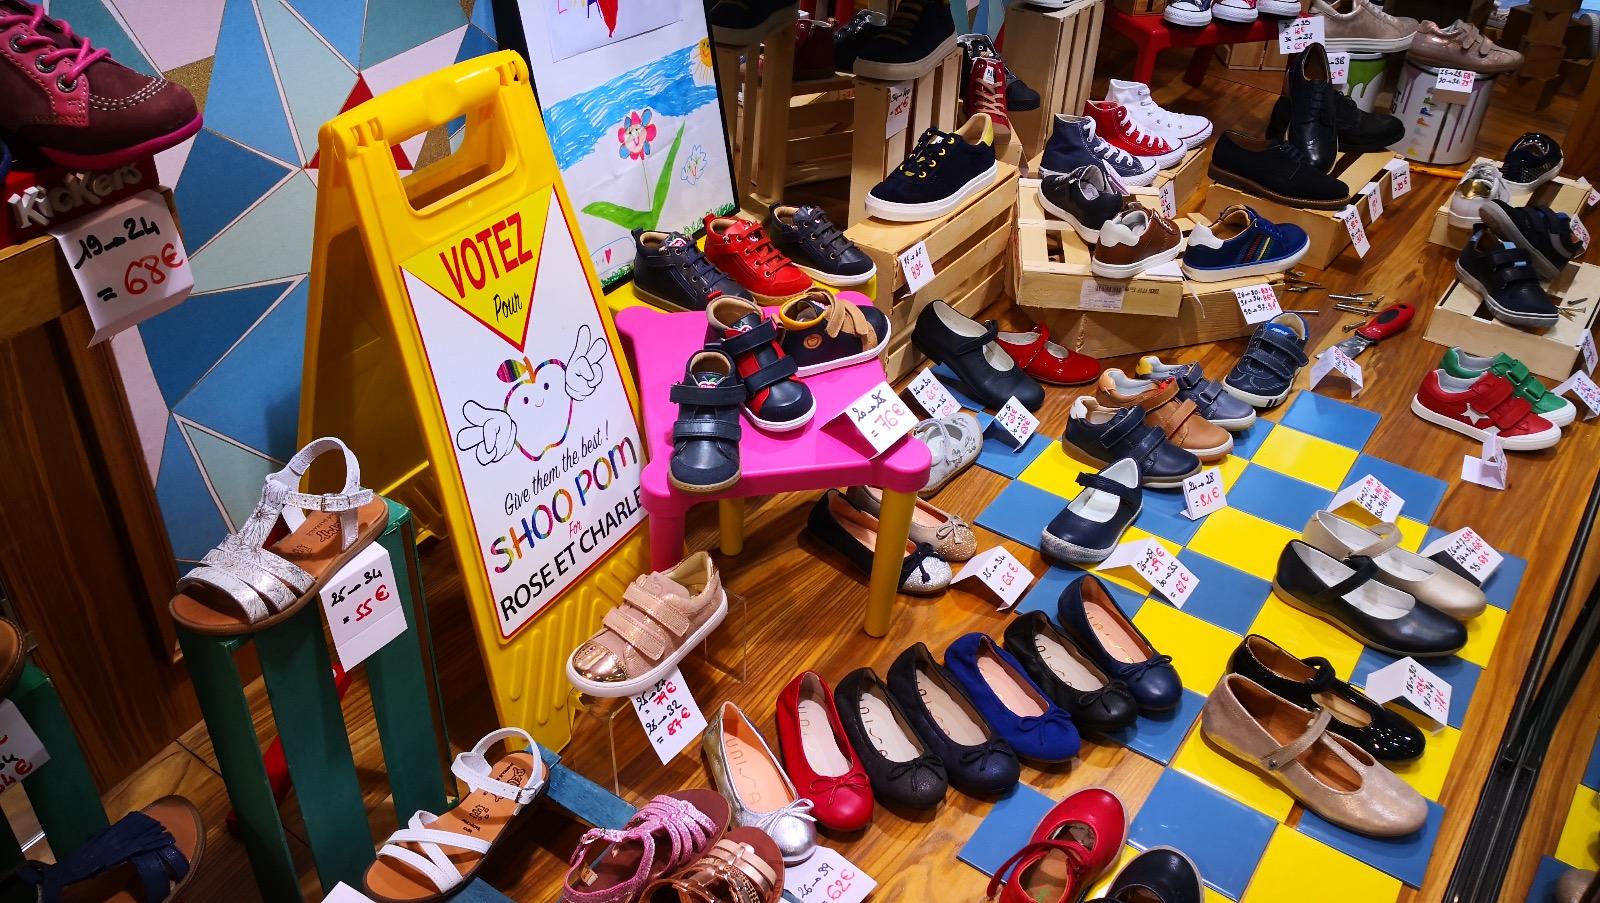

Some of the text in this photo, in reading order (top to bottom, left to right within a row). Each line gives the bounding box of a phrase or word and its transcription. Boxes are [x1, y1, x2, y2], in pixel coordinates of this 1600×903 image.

[74, 217, 160, 269] 19 24
[439, 212, 533, 299] VOTEZ
[124, 243, 183, 294] 68€
[493, 292, 522, 323] Pour
[874, 403, 905, 431] 76€
[504, 488, 530, 516] Give
[532, 464, 560, 495] them
[562, 447, 579, 473] the
[581, 428, 603, 457] best
[491, 488, 573, 574] SHOO
[364, 569, 382, 586] 34
[500, 563, 554, 621] ROSE
[554, 541, 576, 576] ET
[667, 700, 682, 716] 32
[667, 707, 691, 736] 87€
[818, 862, 834, 880] 39
